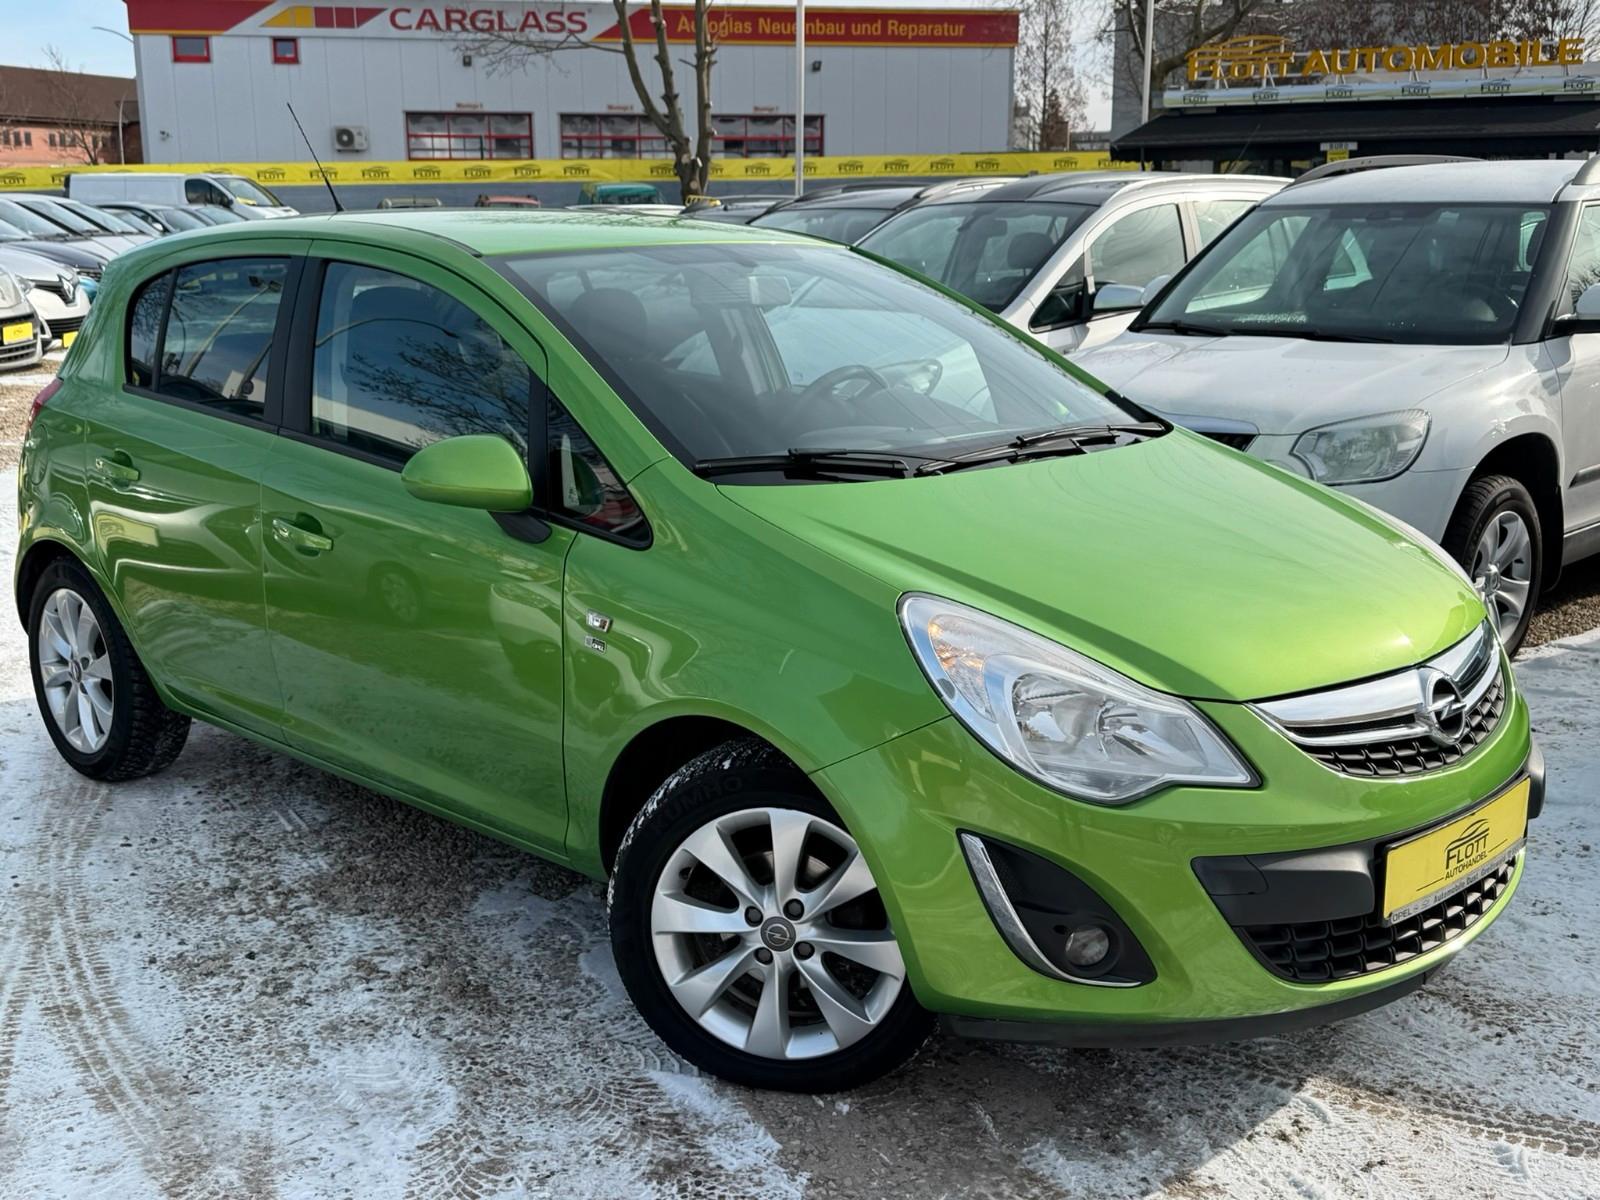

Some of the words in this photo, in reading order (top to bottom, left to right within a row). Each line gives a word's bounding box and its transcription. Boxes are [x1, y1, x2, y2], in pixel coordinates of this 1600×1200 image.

[389, 8, 588, 34] CARGLASS
[851, 19, 882, 36] und
[887, 19, 966, 39] Reparatur
[1301, 37, 1585, 78] AUTOMOBILE
[1444, 851, 1489, 881] AUTOHANDEL
[1445, 834, 1489, 870] FLOTT
